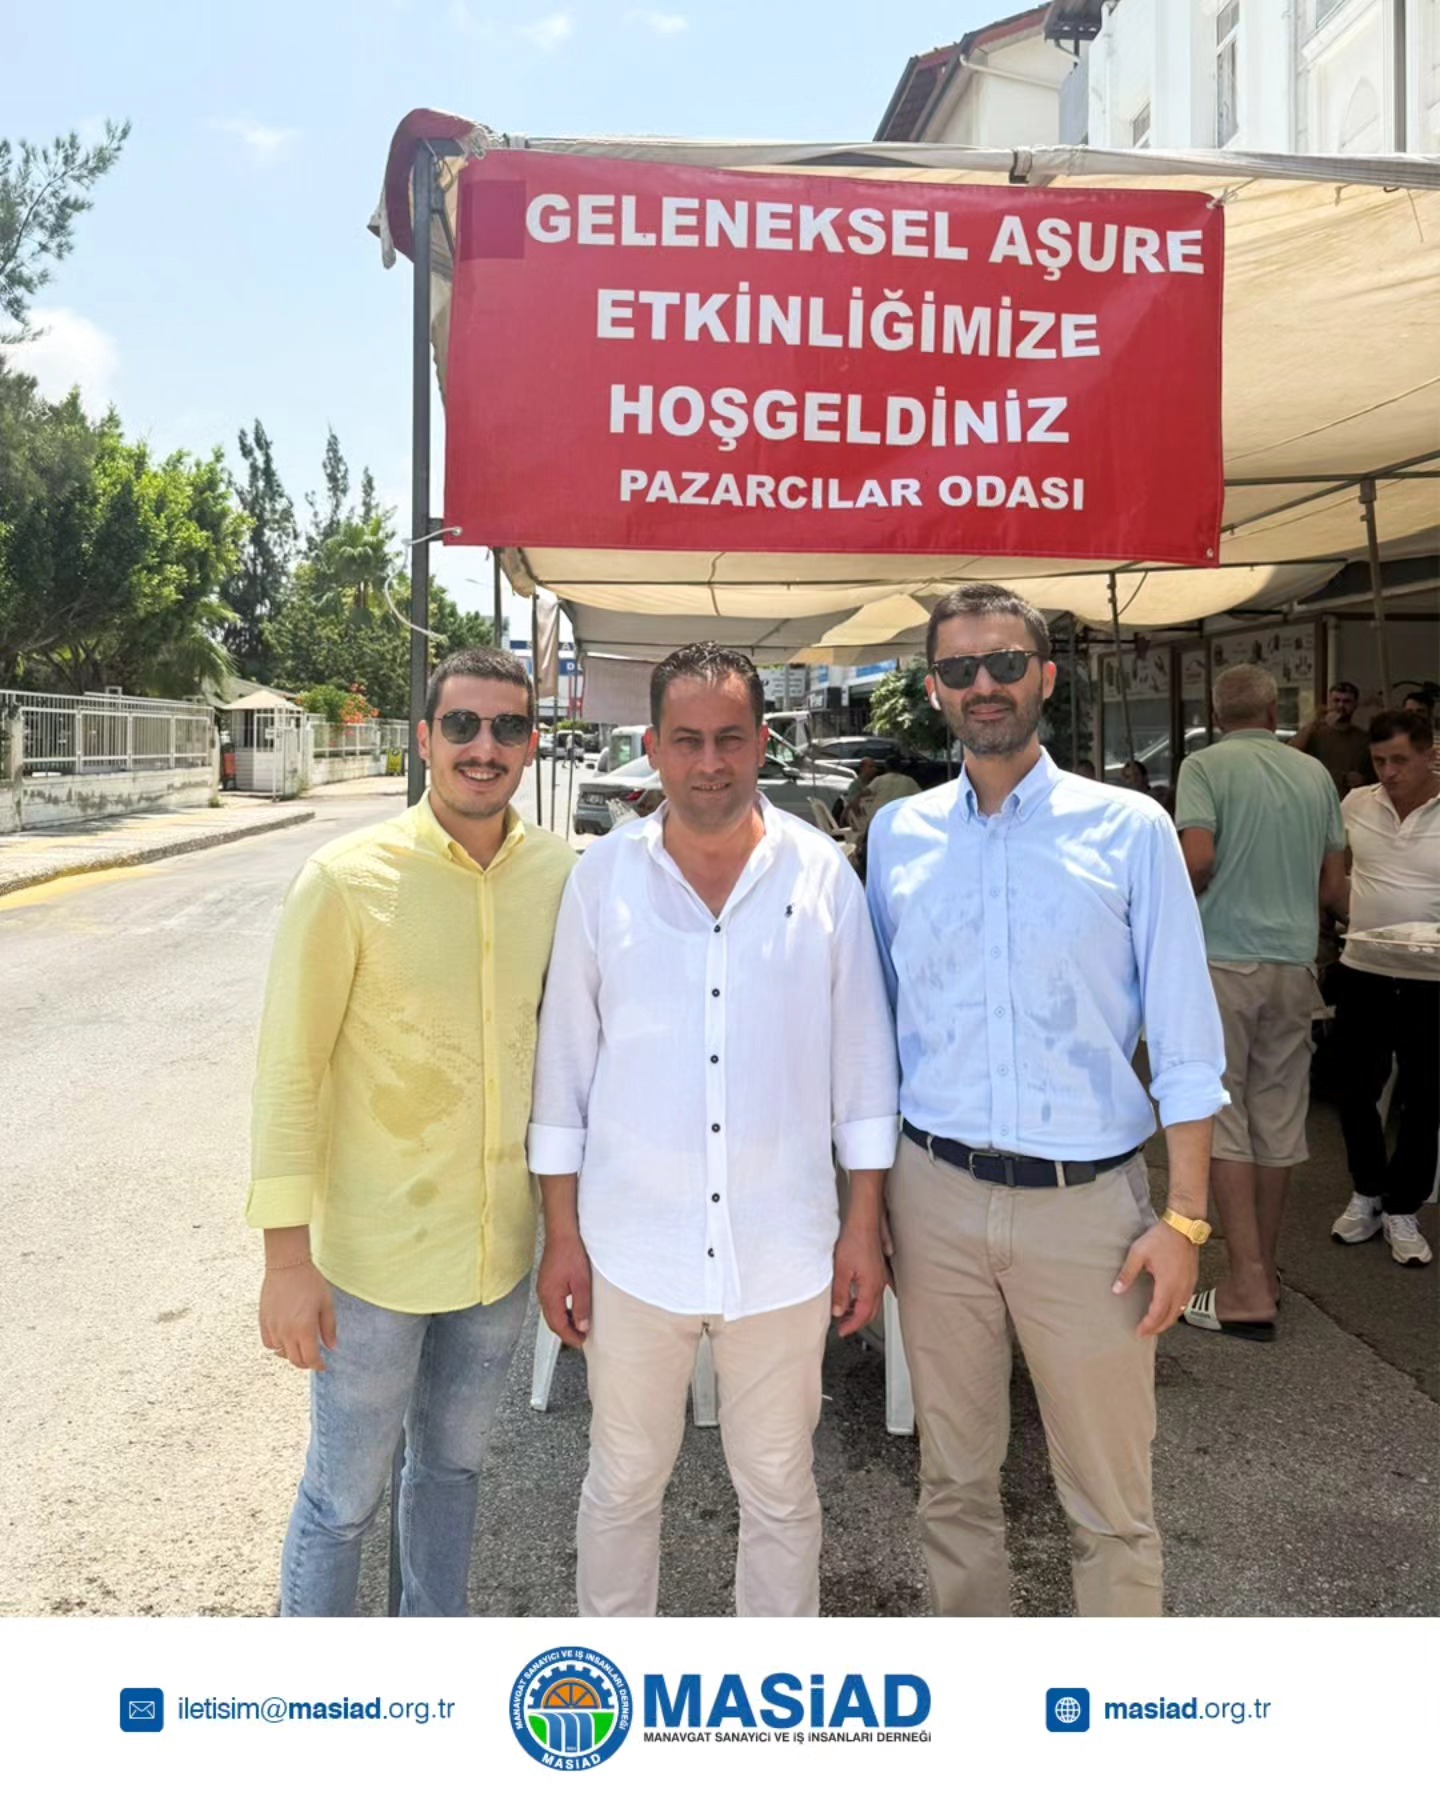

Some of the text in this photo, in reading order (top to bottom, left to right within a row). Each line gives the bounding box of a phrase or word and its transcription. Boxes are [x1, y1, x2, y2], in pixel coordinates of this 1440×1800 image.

[526, 193, 1204, 281] GELENEKSEL AŞURE
[597, 281, 1101, 360] ETKİNLİĞİMİZE
[609, 383, 1069, 452] HOŞGELDİNİZ
[620, 469, 1084, 510] PAZARCILAR ODASI
